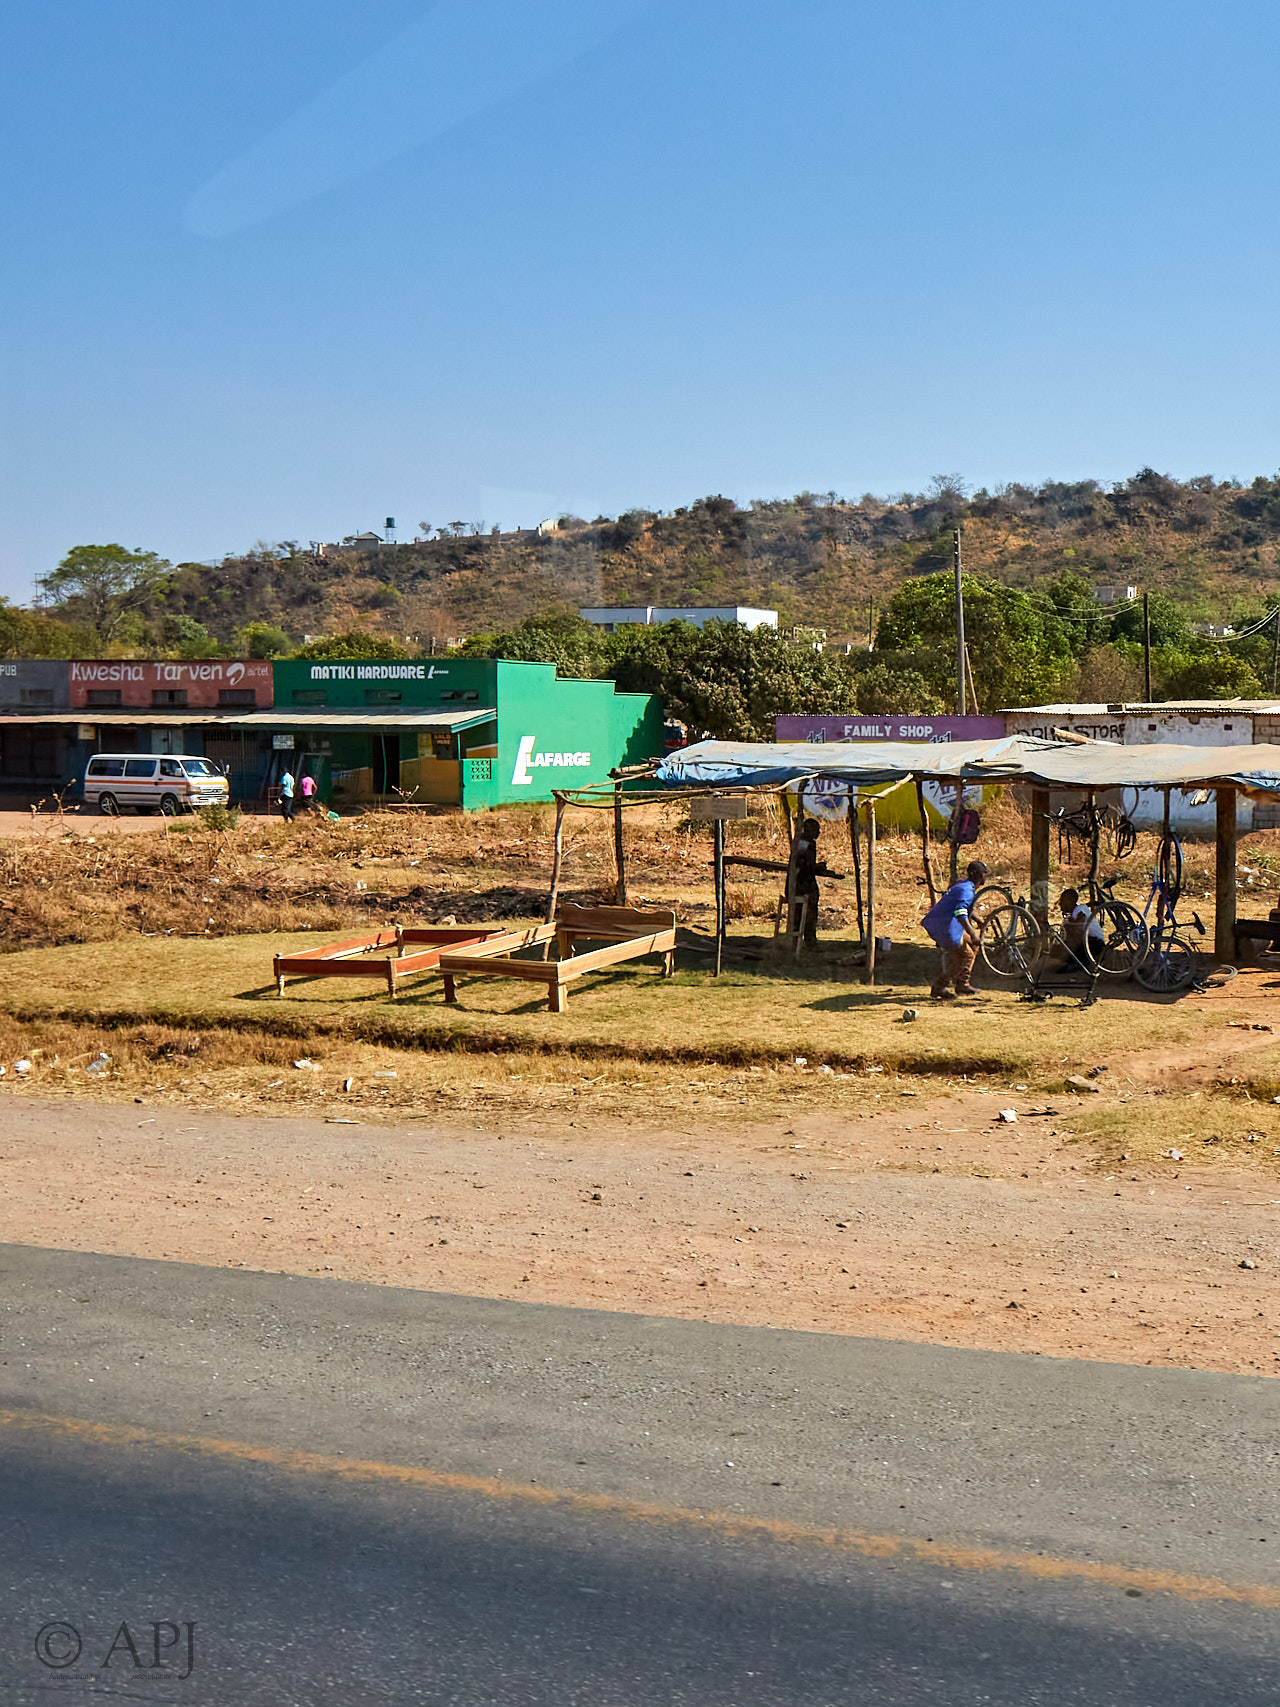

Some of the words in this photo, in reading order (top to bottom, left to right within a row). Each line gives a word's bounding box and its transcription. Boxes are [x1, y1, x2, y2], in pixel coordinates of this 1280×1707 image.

[71, 663, 144, 681] Kwesha
[154, 663, 223, 680] Tarven
[310, 665, 355, 680] MATIKI
[357, 665, 426, 680] HARDWARE
[844, 725, 892, 737] FAMILY
[899, 725, 933, 738] SHOP
